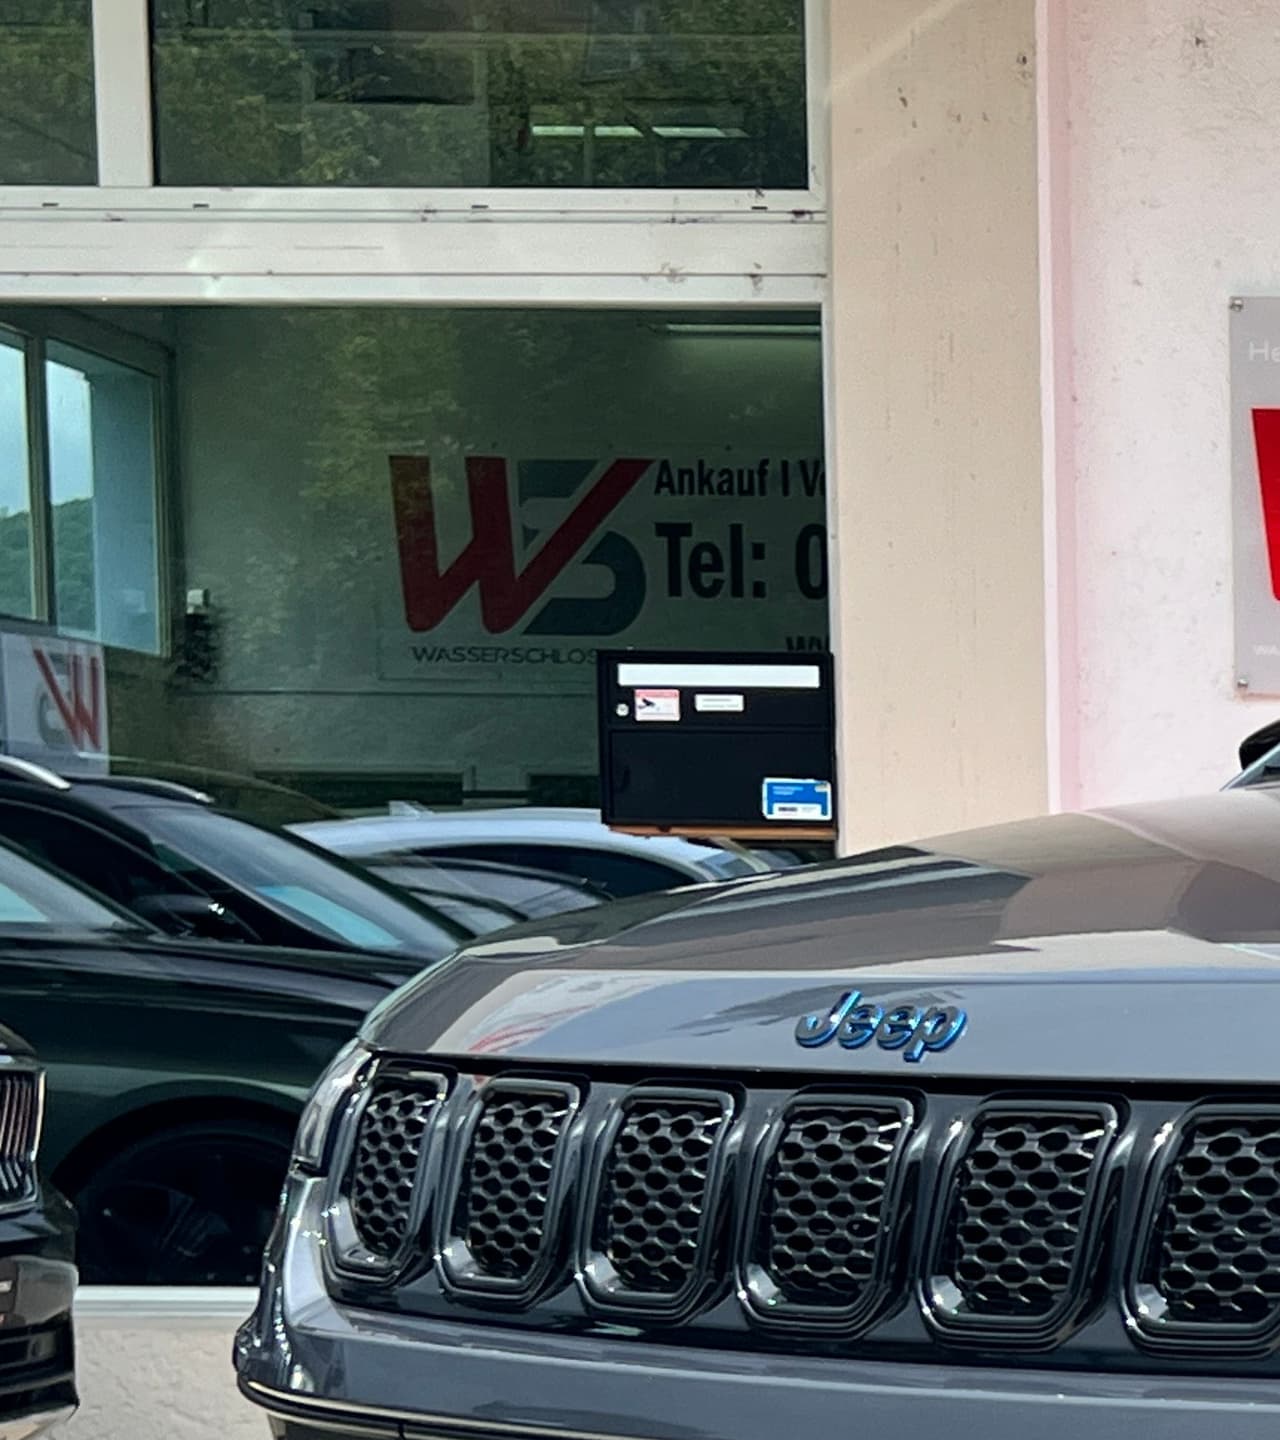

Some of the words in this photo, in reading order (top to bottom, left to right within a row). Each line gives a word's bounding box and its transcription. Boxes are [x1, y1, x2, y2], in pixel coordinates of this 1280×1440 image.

[654, 459, 769, 497] Ankauf
[654, 521, 767, 599] Tel:
[794, 989, 968, 1063] Jeep
